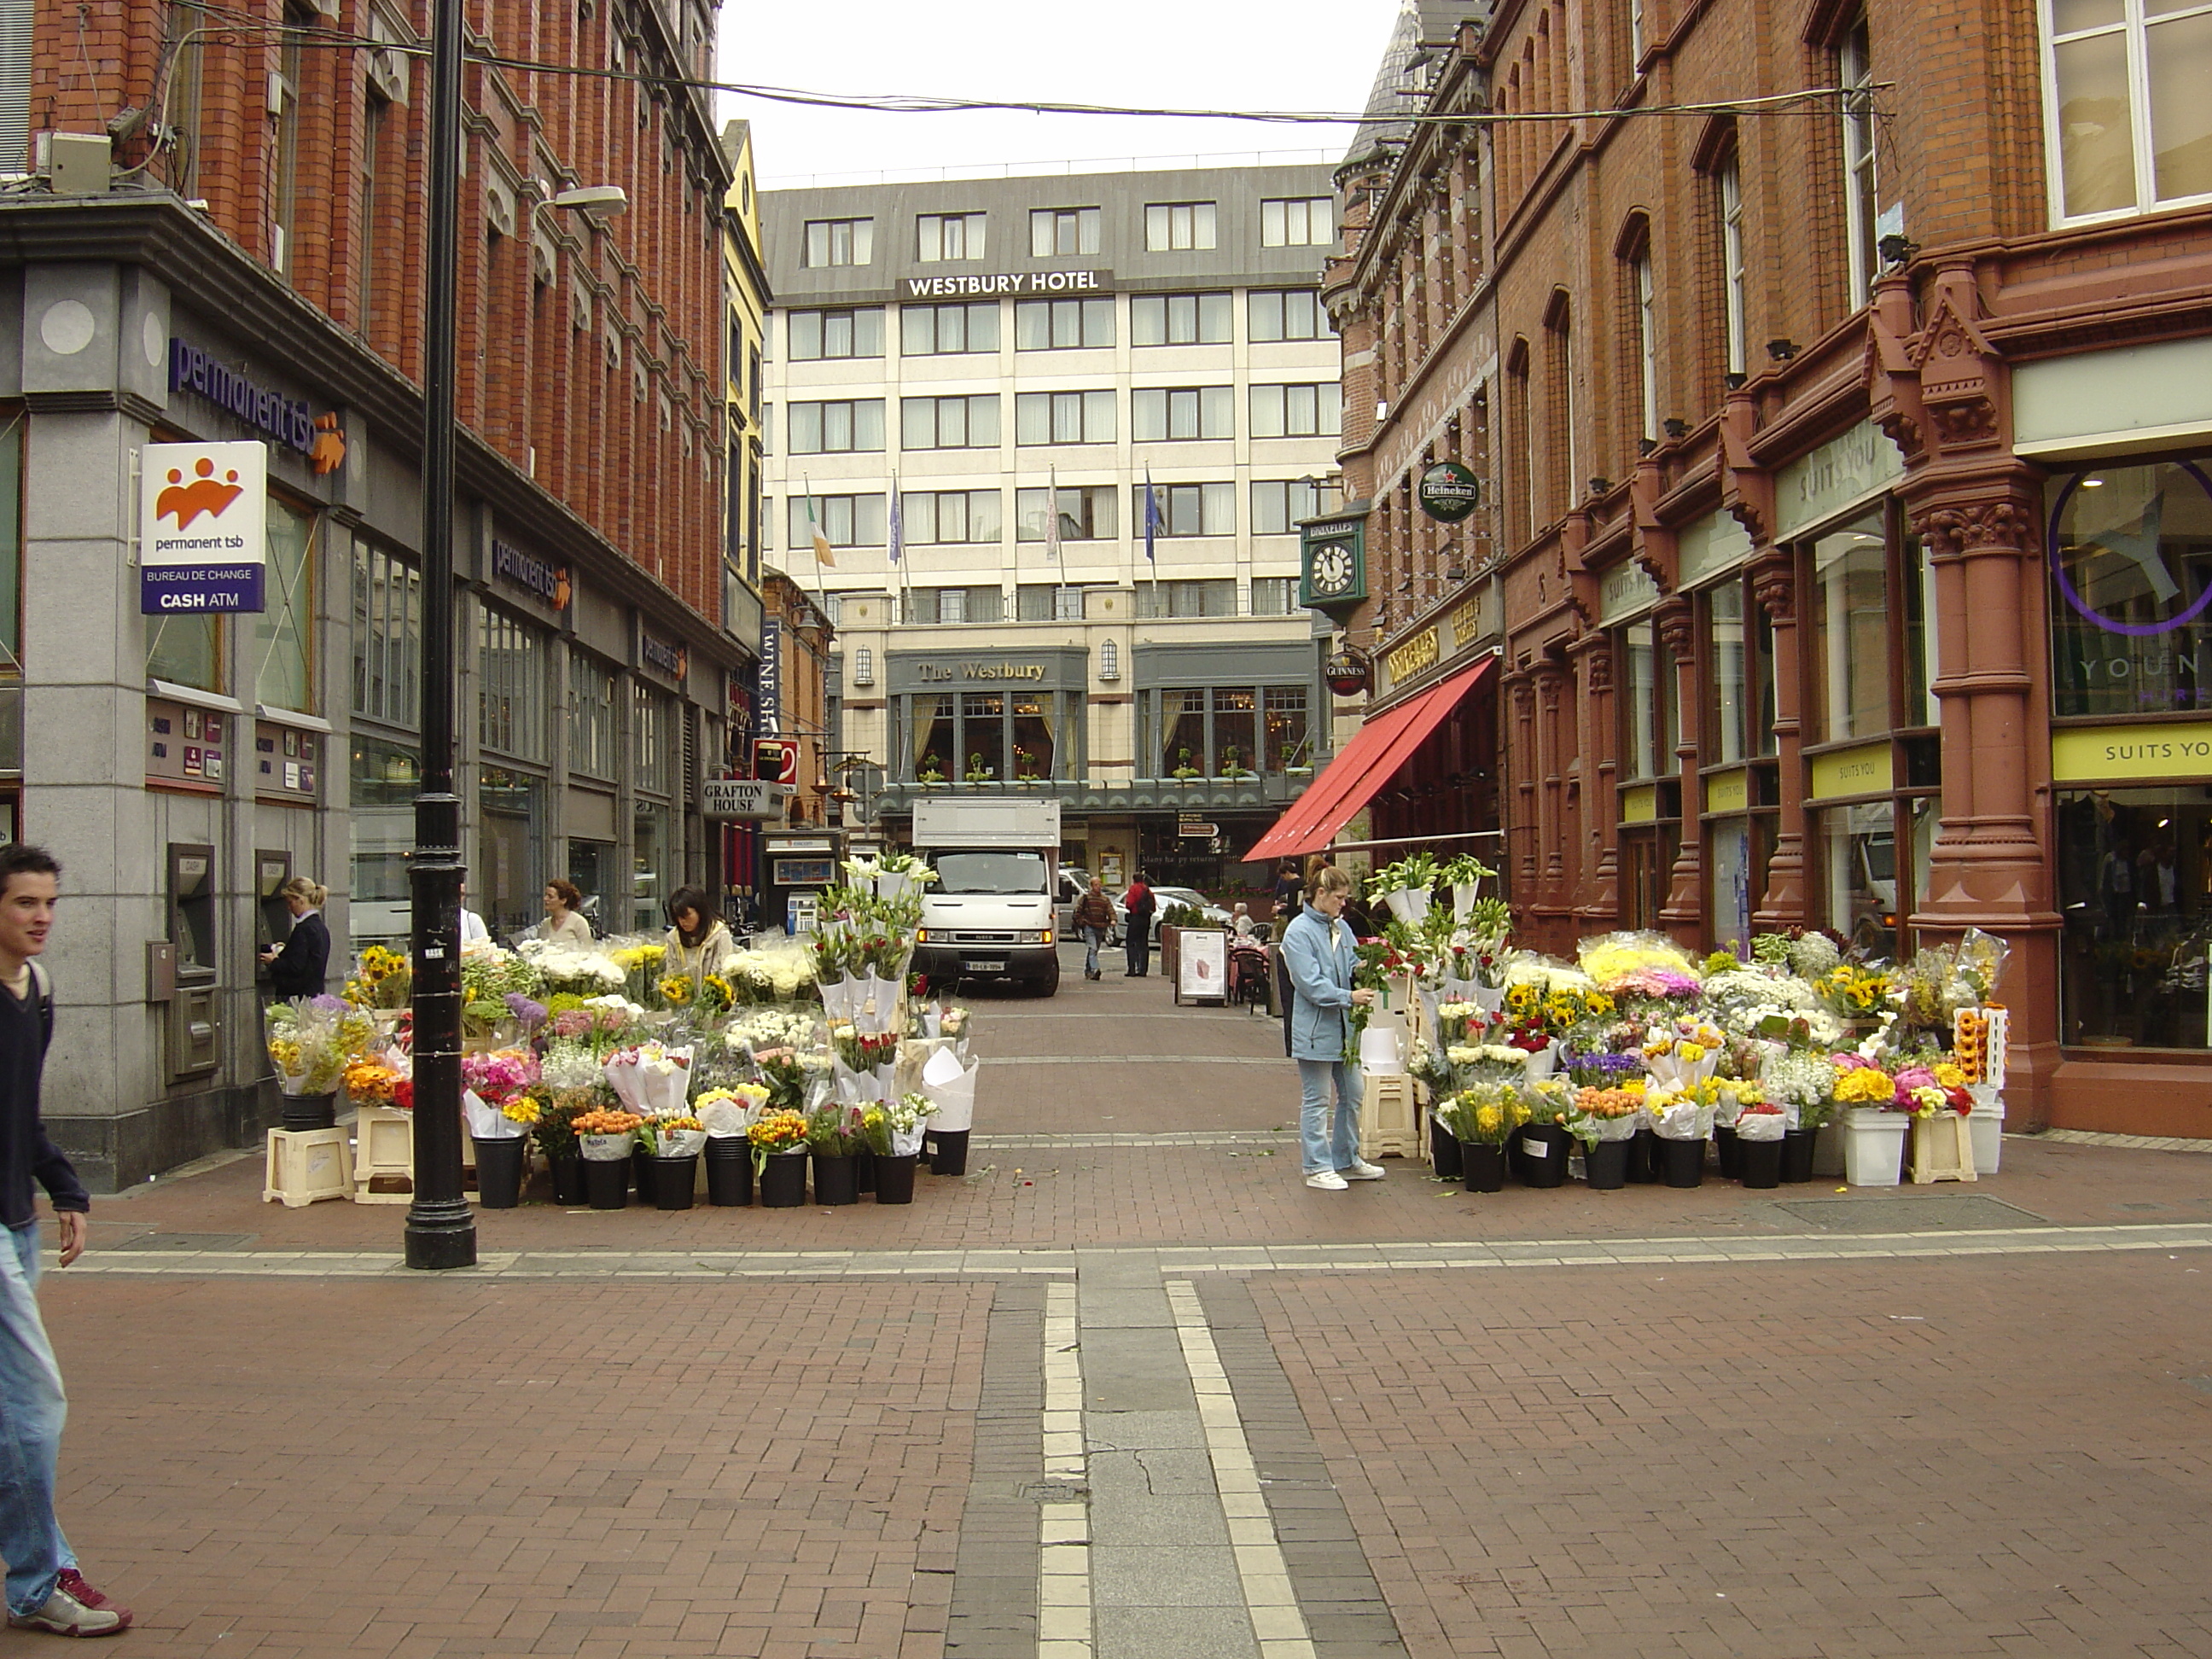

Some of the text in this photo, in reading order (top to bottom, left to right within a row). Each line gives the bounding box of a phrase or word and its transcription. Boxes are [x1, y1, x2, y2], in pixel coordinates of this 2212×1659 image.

[909, 271, 1098, 296] WESTBURY HOTEL
[170, 338, 317, 455] permanent tsb
[1801, 436, 1875, 502] SUITS YOU
[1427, 486, 1472, 496] Heineken
[1310, 522, 1353, 537] BRUXELLES
[156, 534, 243, 551] permanent tsb
[492, 539, 544, 593] permanent
[147, 570, 252, 582] BUREAU DE CHANGE
[160, 593, 238, 608] CASH ATM
[760, 633, 774, 690] WINE
[917, 661, 1045, 681] The Westbury
[1327, 667, 1365, 676] GUINNESS
[2106, 743, 2172, 760] SUITS
[1840, 762, 1875, 779] SUITS YOU
[704, 785, 762, 798] GRAFTON
[1718, 784, 1743, 799] SUITS YOU
[713, 799, 754, 812] HOUSE
